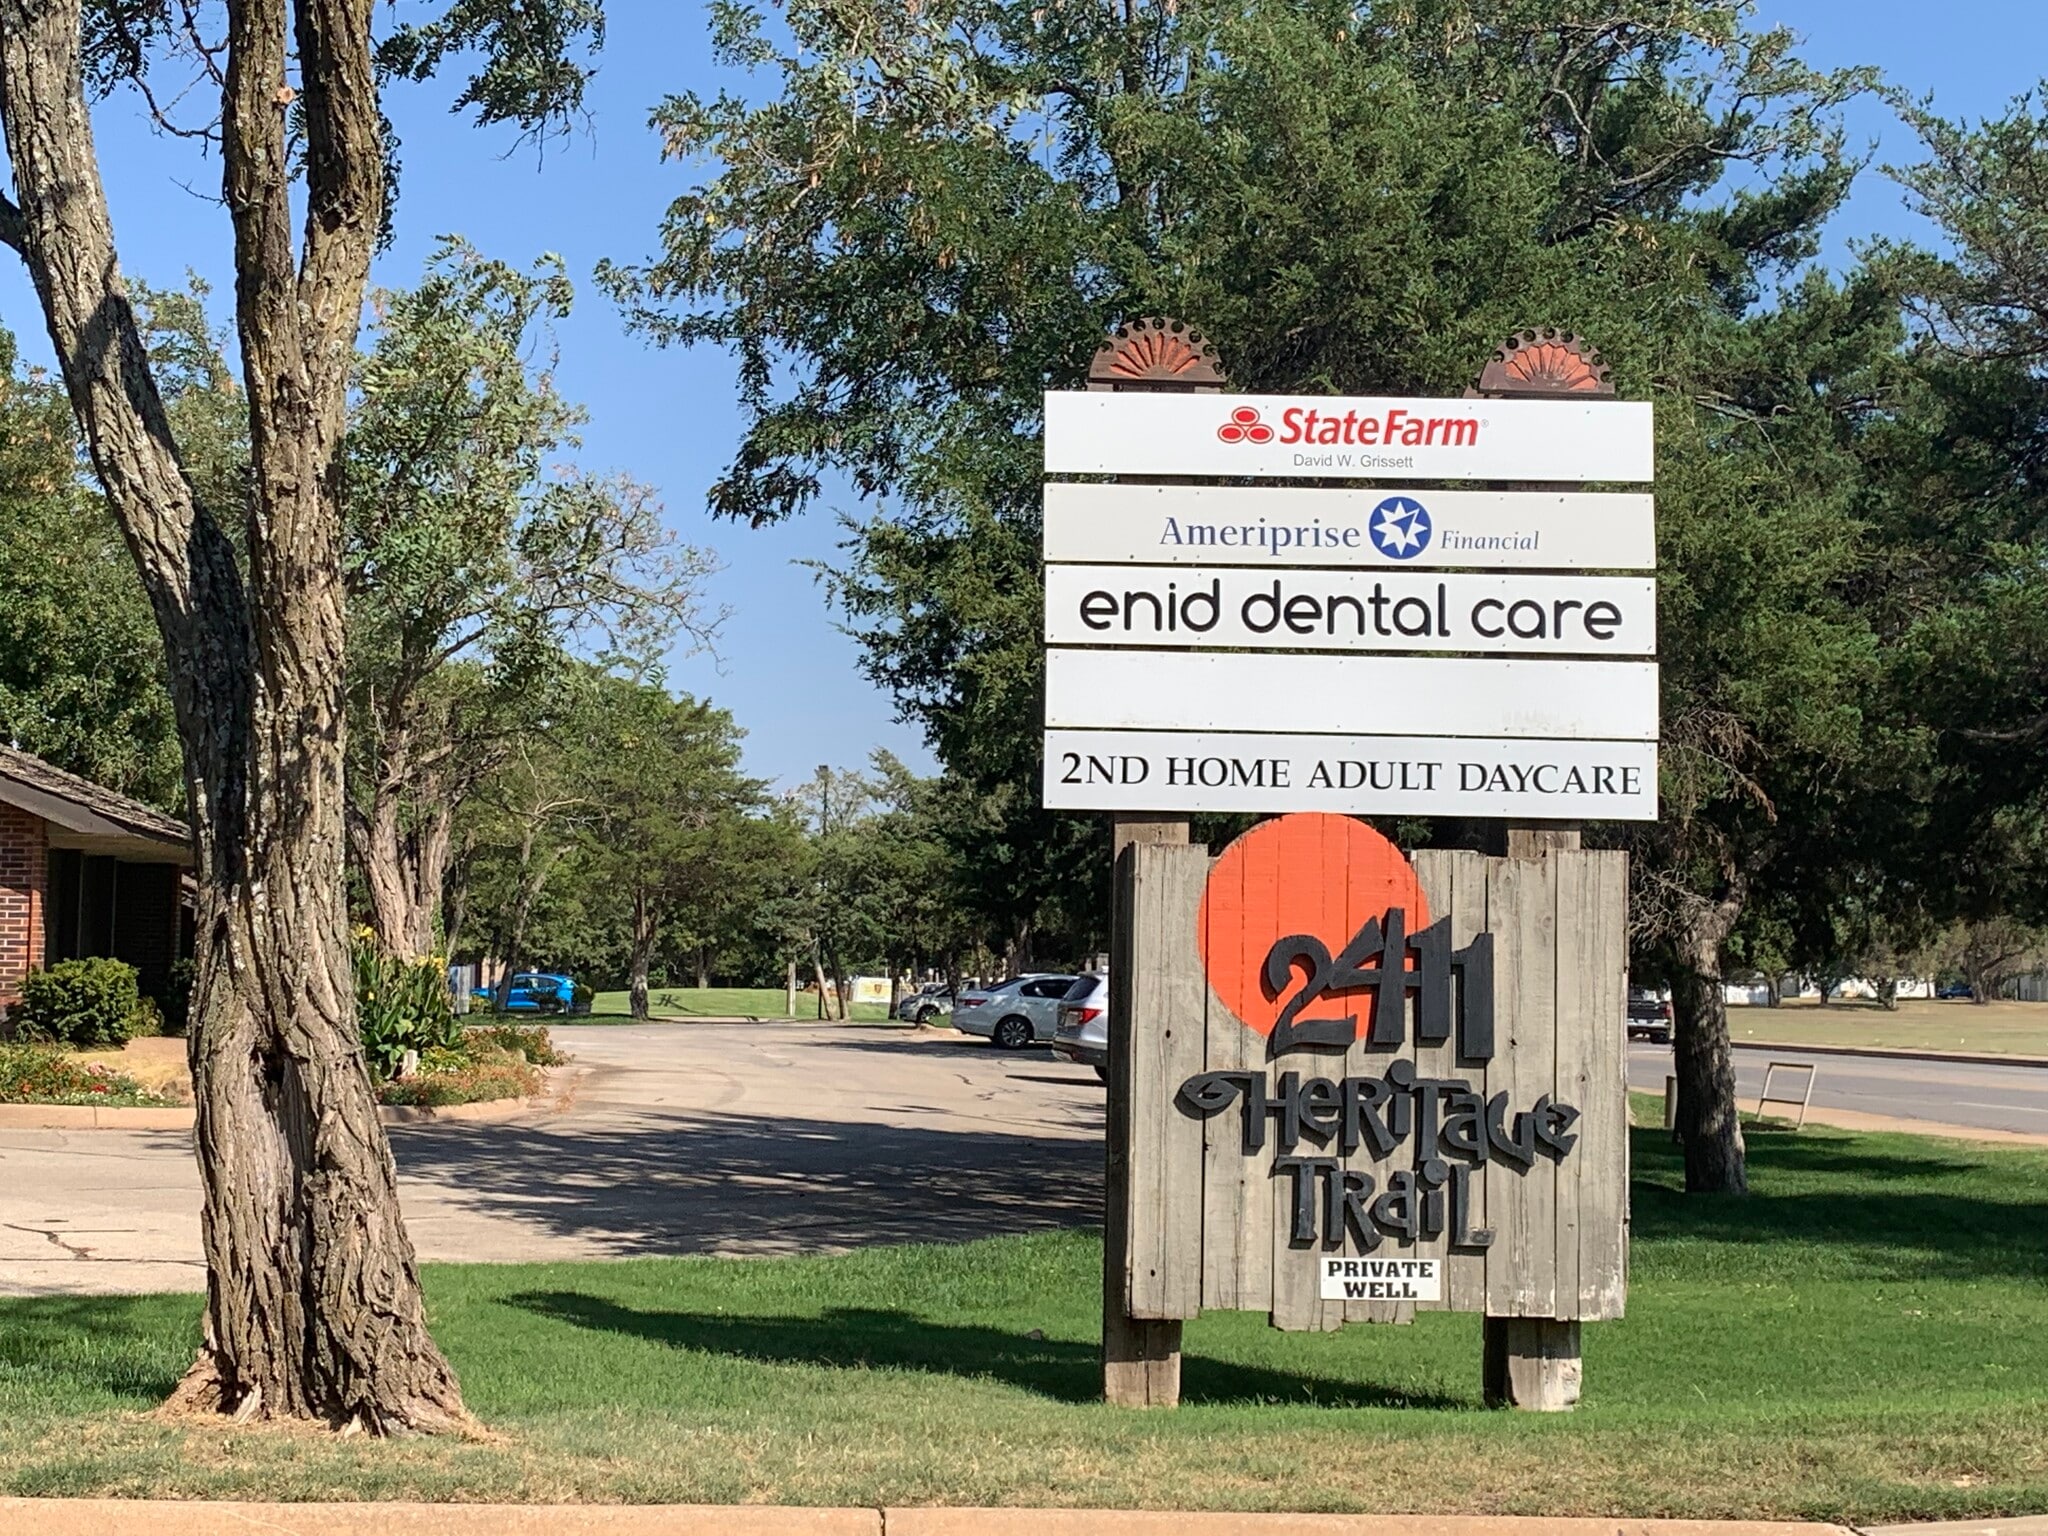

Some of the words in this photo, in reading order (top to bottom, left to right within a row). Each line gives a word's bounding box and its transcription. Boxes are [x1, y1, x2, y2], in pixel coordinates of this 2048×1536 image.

[1293, 454, 1332, 467] David
[1336, 454, 1355, 467] W.
[1360, 454, 1414, 468] Grissett
[1159, 516, 1361, 556] Ameriprise
[1440, 529, 1540, 551] Financial
[1079, 577, 1221, 632] enid
[1241, 579, 1451, 638] dental
[1471, 598, 1623, 640] care
[1061, 752, 1150, 785] 2ND
[1166, 756, 1292, 789] HOME
[1306, 760, 1443, 792] ADULT
[1458, 763, 1643, 796] DAYCARE
[1263, 907, 1494, 1060] 2411
[1328, 1260, 1434, 1279] PRIVATE
[1343, 1281, 1418, 1300] WELL
